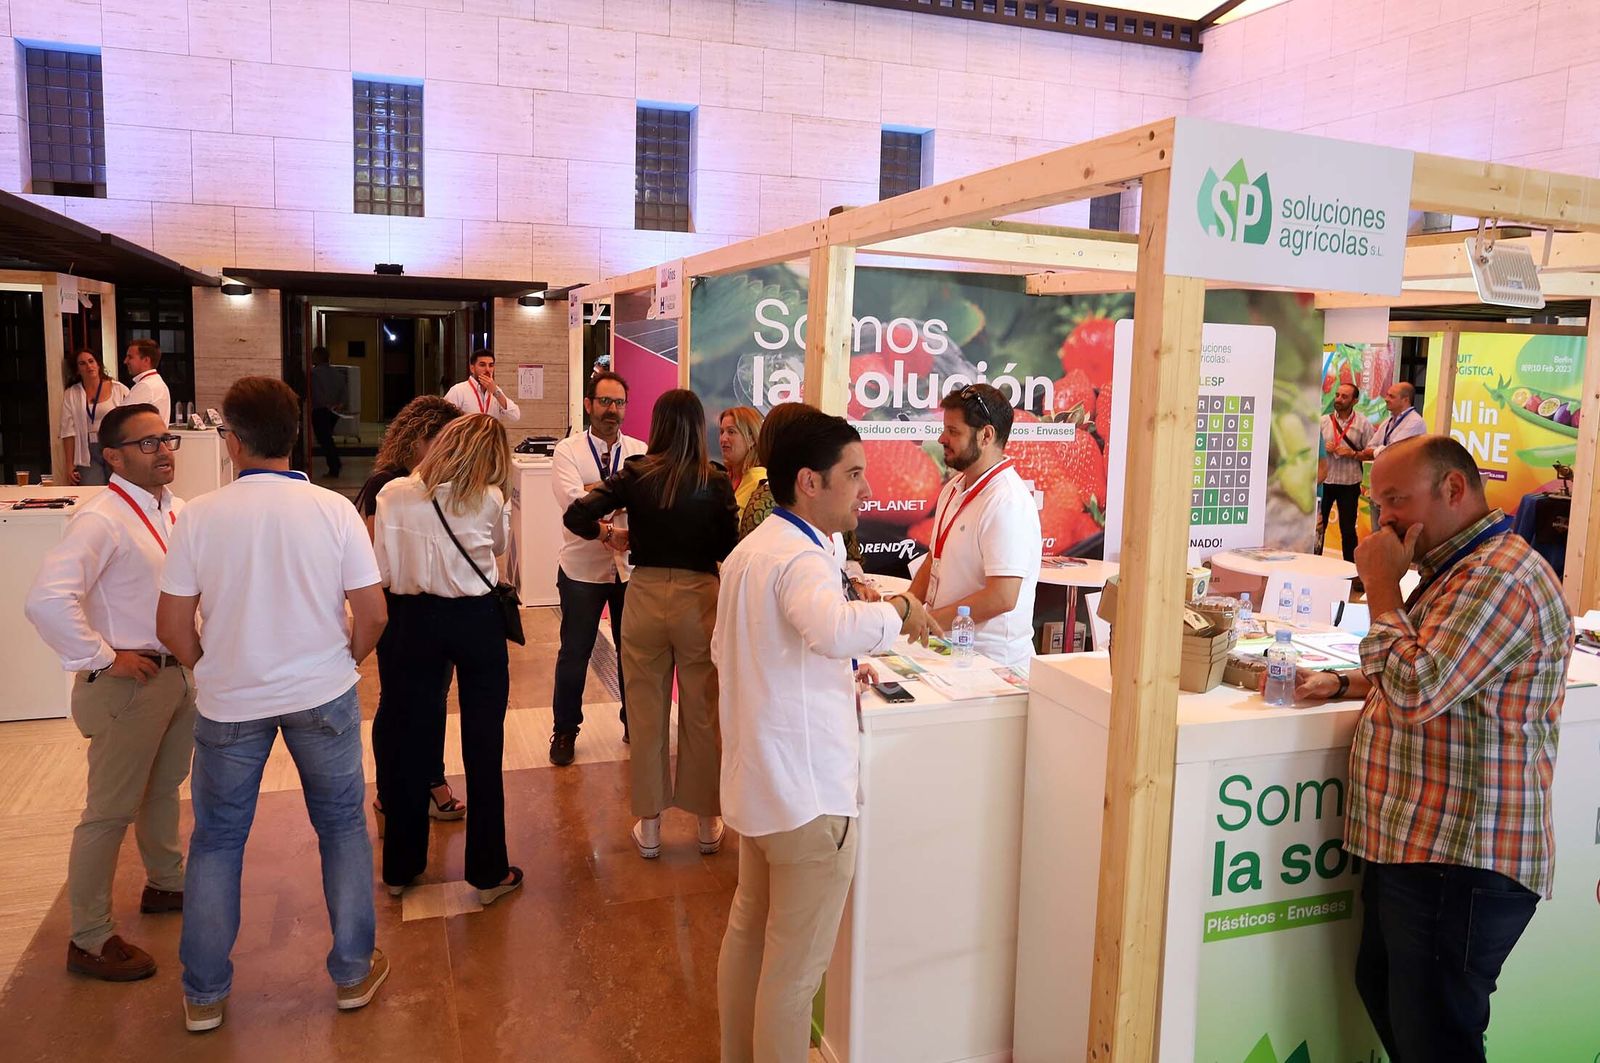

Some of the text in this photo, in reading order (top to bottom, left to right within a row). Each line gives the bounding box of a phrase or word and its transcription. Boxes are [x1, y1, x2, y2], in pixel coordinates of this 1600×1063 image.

[1204, 180, 1263, 243] SP
[1281, 194, 1386, 231] soluciones
[1279, 223, 1369, 257] agrícolas
[752, 356, 803, 407] la
[893, 426, 917, 434] cero
[1478, 399, 1498, 425] in
[1036, 426, 1074, 436] Envases
[1211, 840, 1263, 897] la
[1206, 898, 1347, 934] Plásticos Envases
